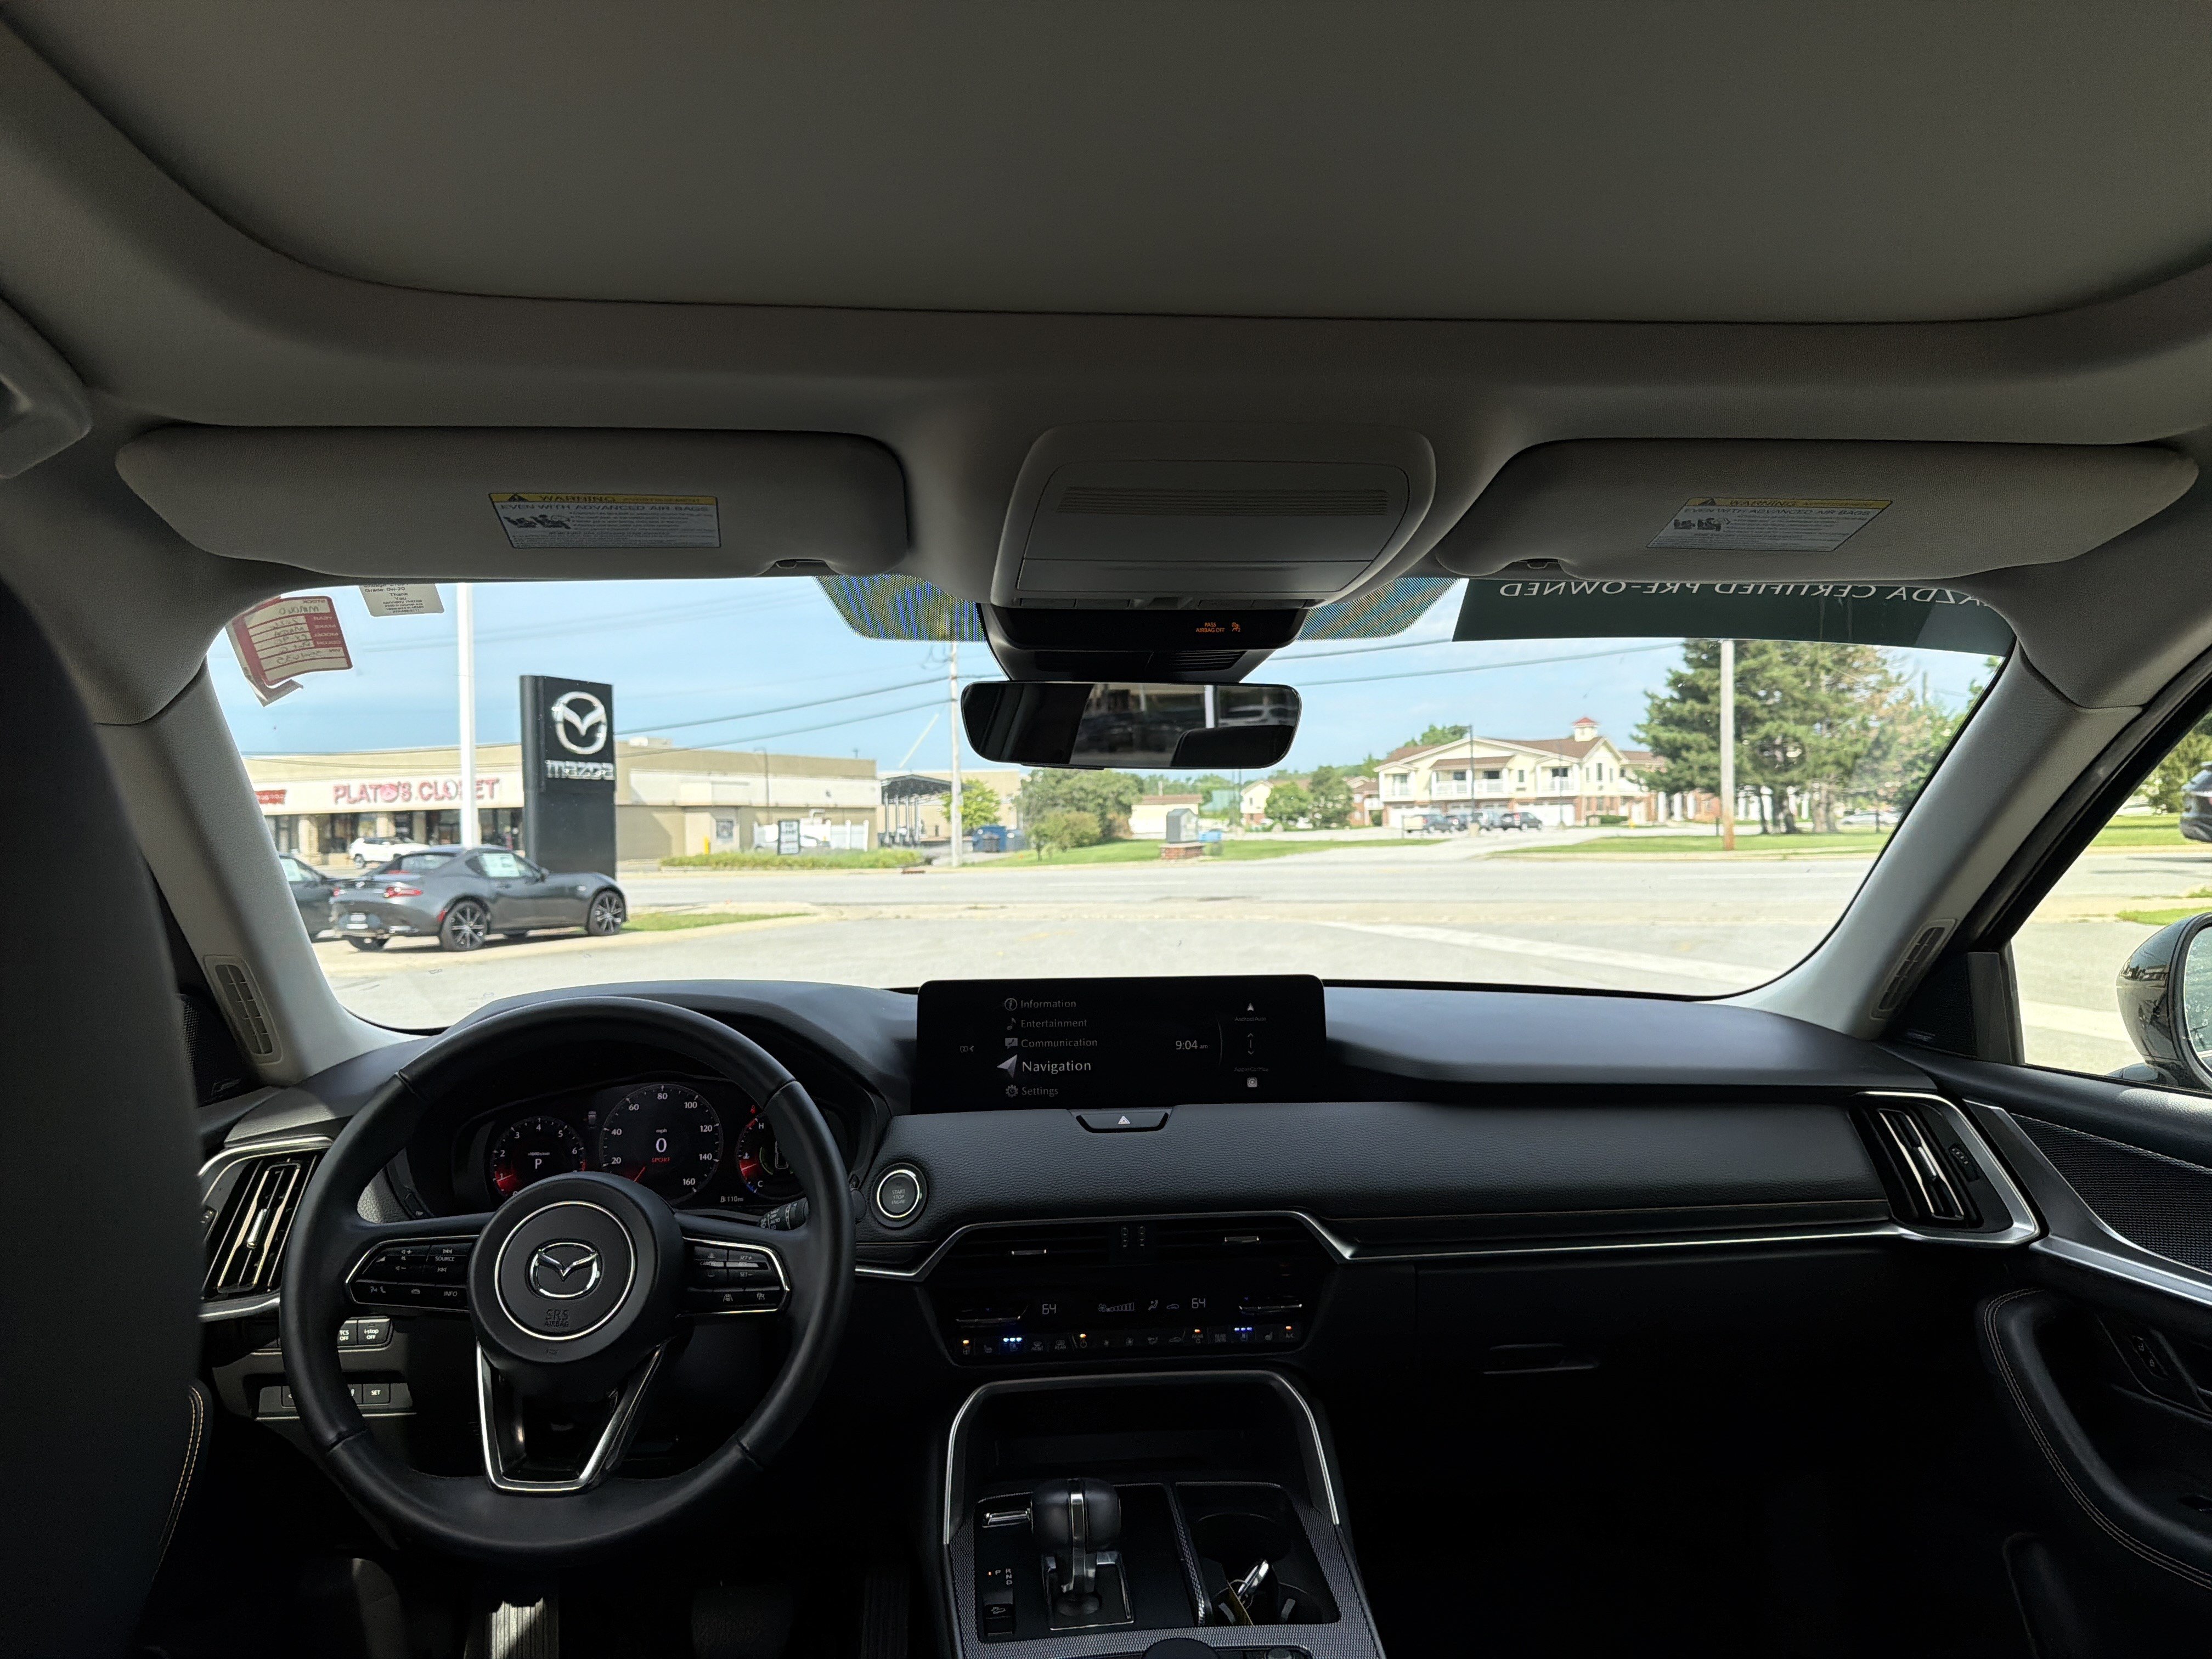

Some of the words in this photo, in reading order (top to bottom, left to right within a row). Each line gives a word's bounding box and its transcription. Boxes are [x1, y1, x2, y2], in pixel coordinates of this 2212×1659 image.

[334, 780, 413, 804] PLATO'S
[417, 778, 500, 802] CLOET
[1020, 999, 1076, 1009] Information
[1020, 1018, 1088, 1028] Entertainment
[1020, 1038, 1098, 1048] Communication
[1175, 1040, 1198, 1050] 9:04
[1022, 1060, 1092, 1074] Navigation
[1021, 1086, 1059, 1097] Settings
[699, 1124, 713, 1132] 120
[656, 1137, 667, 1153] 0
[499, 1149, 505, 1158] 2
[535, 1158, 543, 1170] P
[1191, 1297, 1206, 1309] 64
[545, 1308, 569, 1321] SRS
[1042, 1303, 1057, 1315] 64
